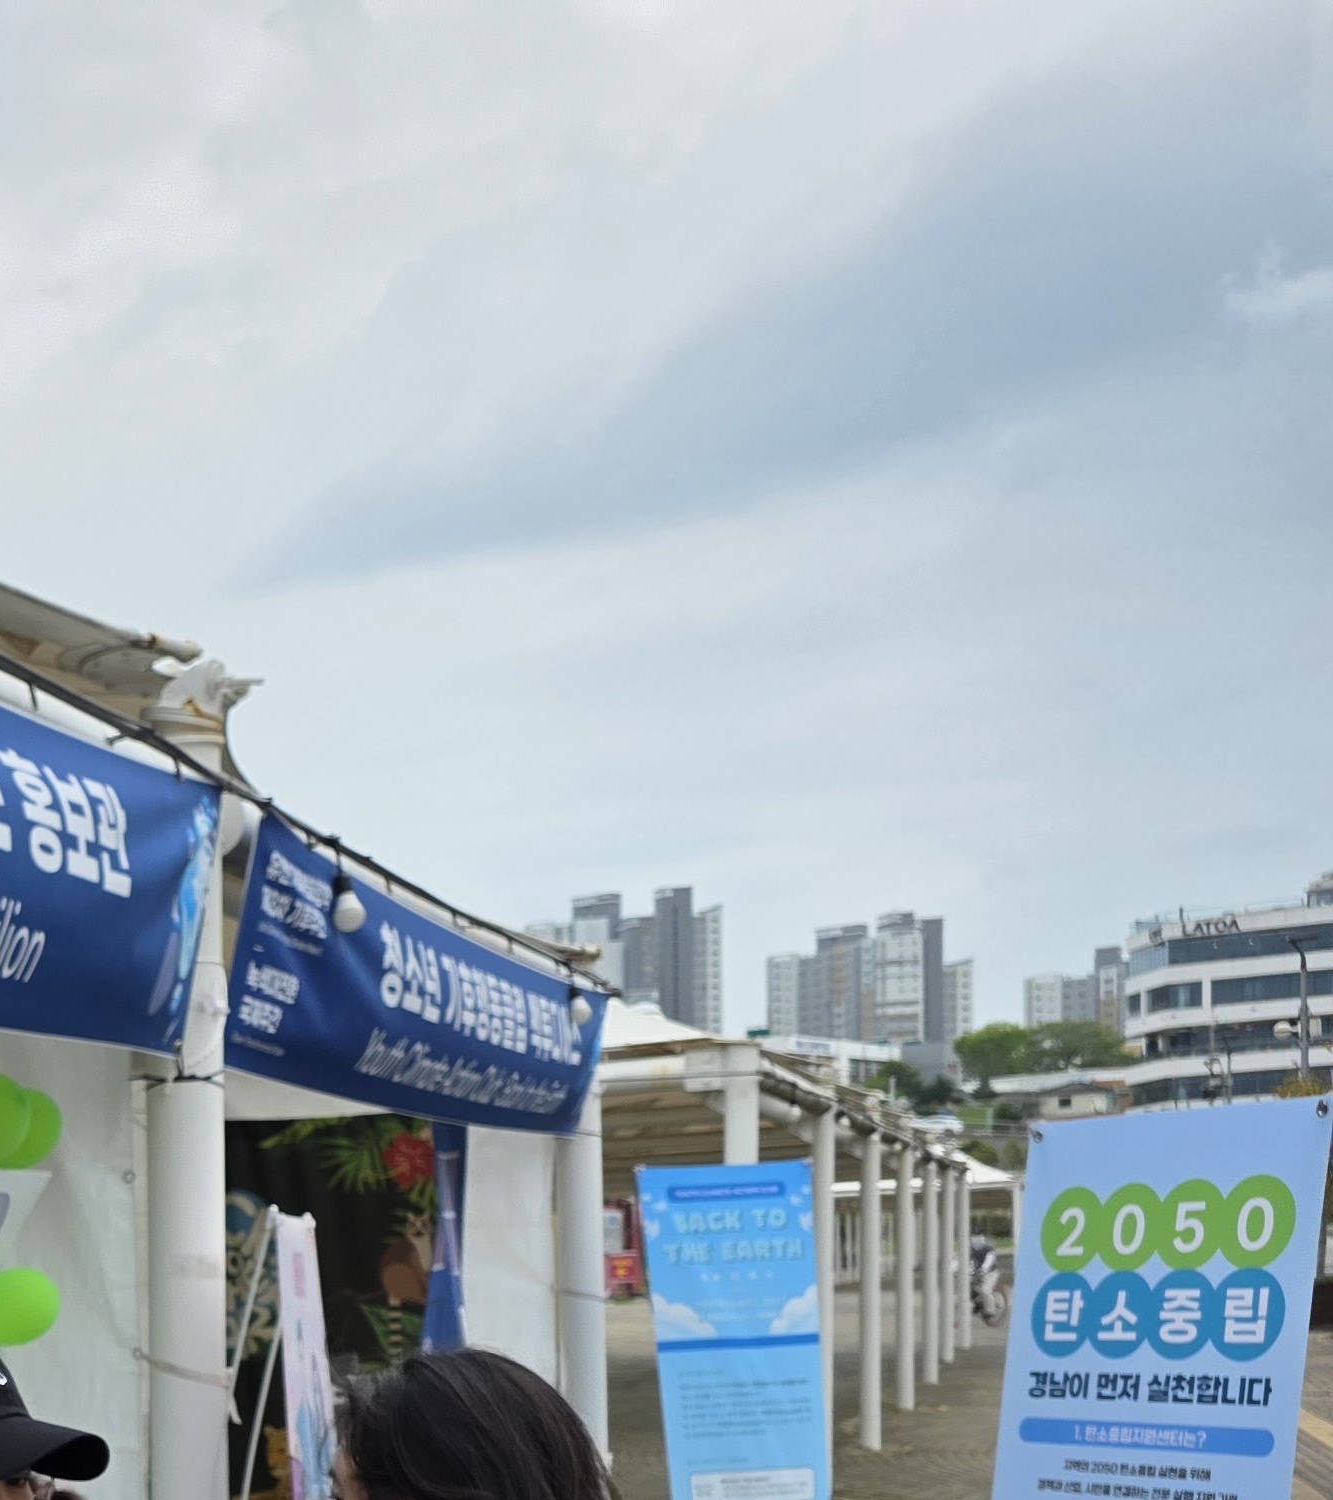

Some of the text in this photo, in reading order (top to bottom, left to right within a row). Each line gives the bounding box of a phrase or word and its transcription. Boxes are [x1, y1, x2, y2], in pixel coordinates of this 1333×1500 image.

[380, 921, 442, 1024] 청소년
[751, 1207, 788, 1230] TO
[1055, 1196, 1276, 1257] 2050
[663, 1237, 804, 1265] THE EARTH
[1044, 1286, 1271, 1345] 탄소중립
[1028, 1372, 1273, 1407] 경남이 먼저 실천합니다
